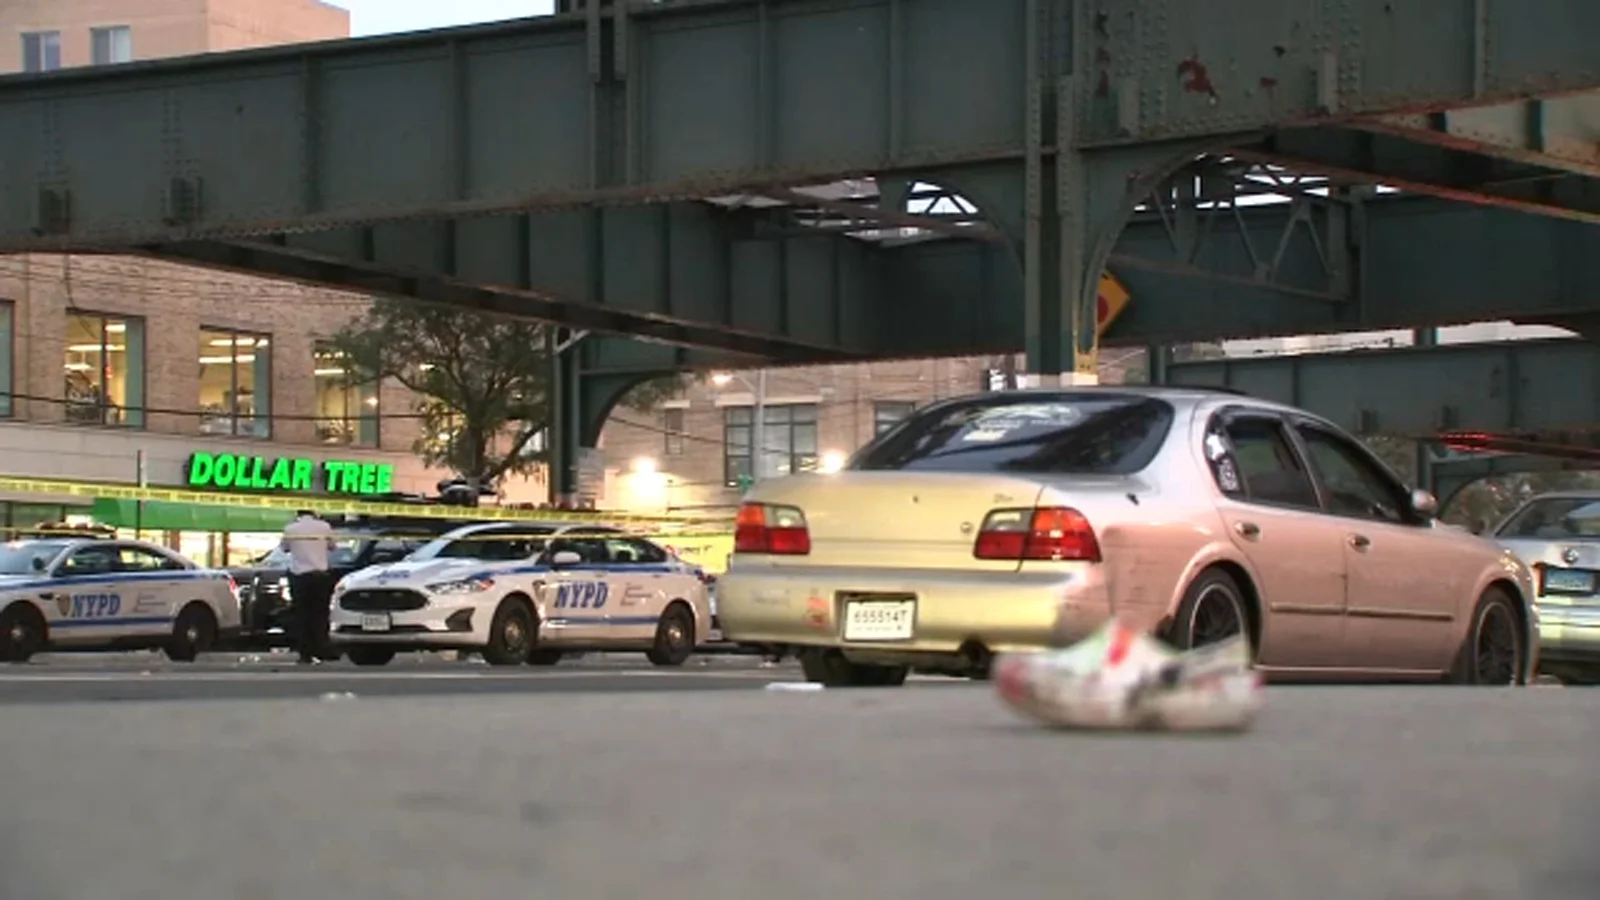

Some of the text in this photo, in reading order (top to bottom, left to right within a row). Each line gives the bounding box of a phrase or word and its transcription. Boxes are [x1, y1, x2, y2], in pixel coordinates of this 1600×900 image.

[189, 452, 393, 493] DOLLAR TREE
[71, 593, 121, 618] NYPD
[554, 581, 609, 609] NYPD
